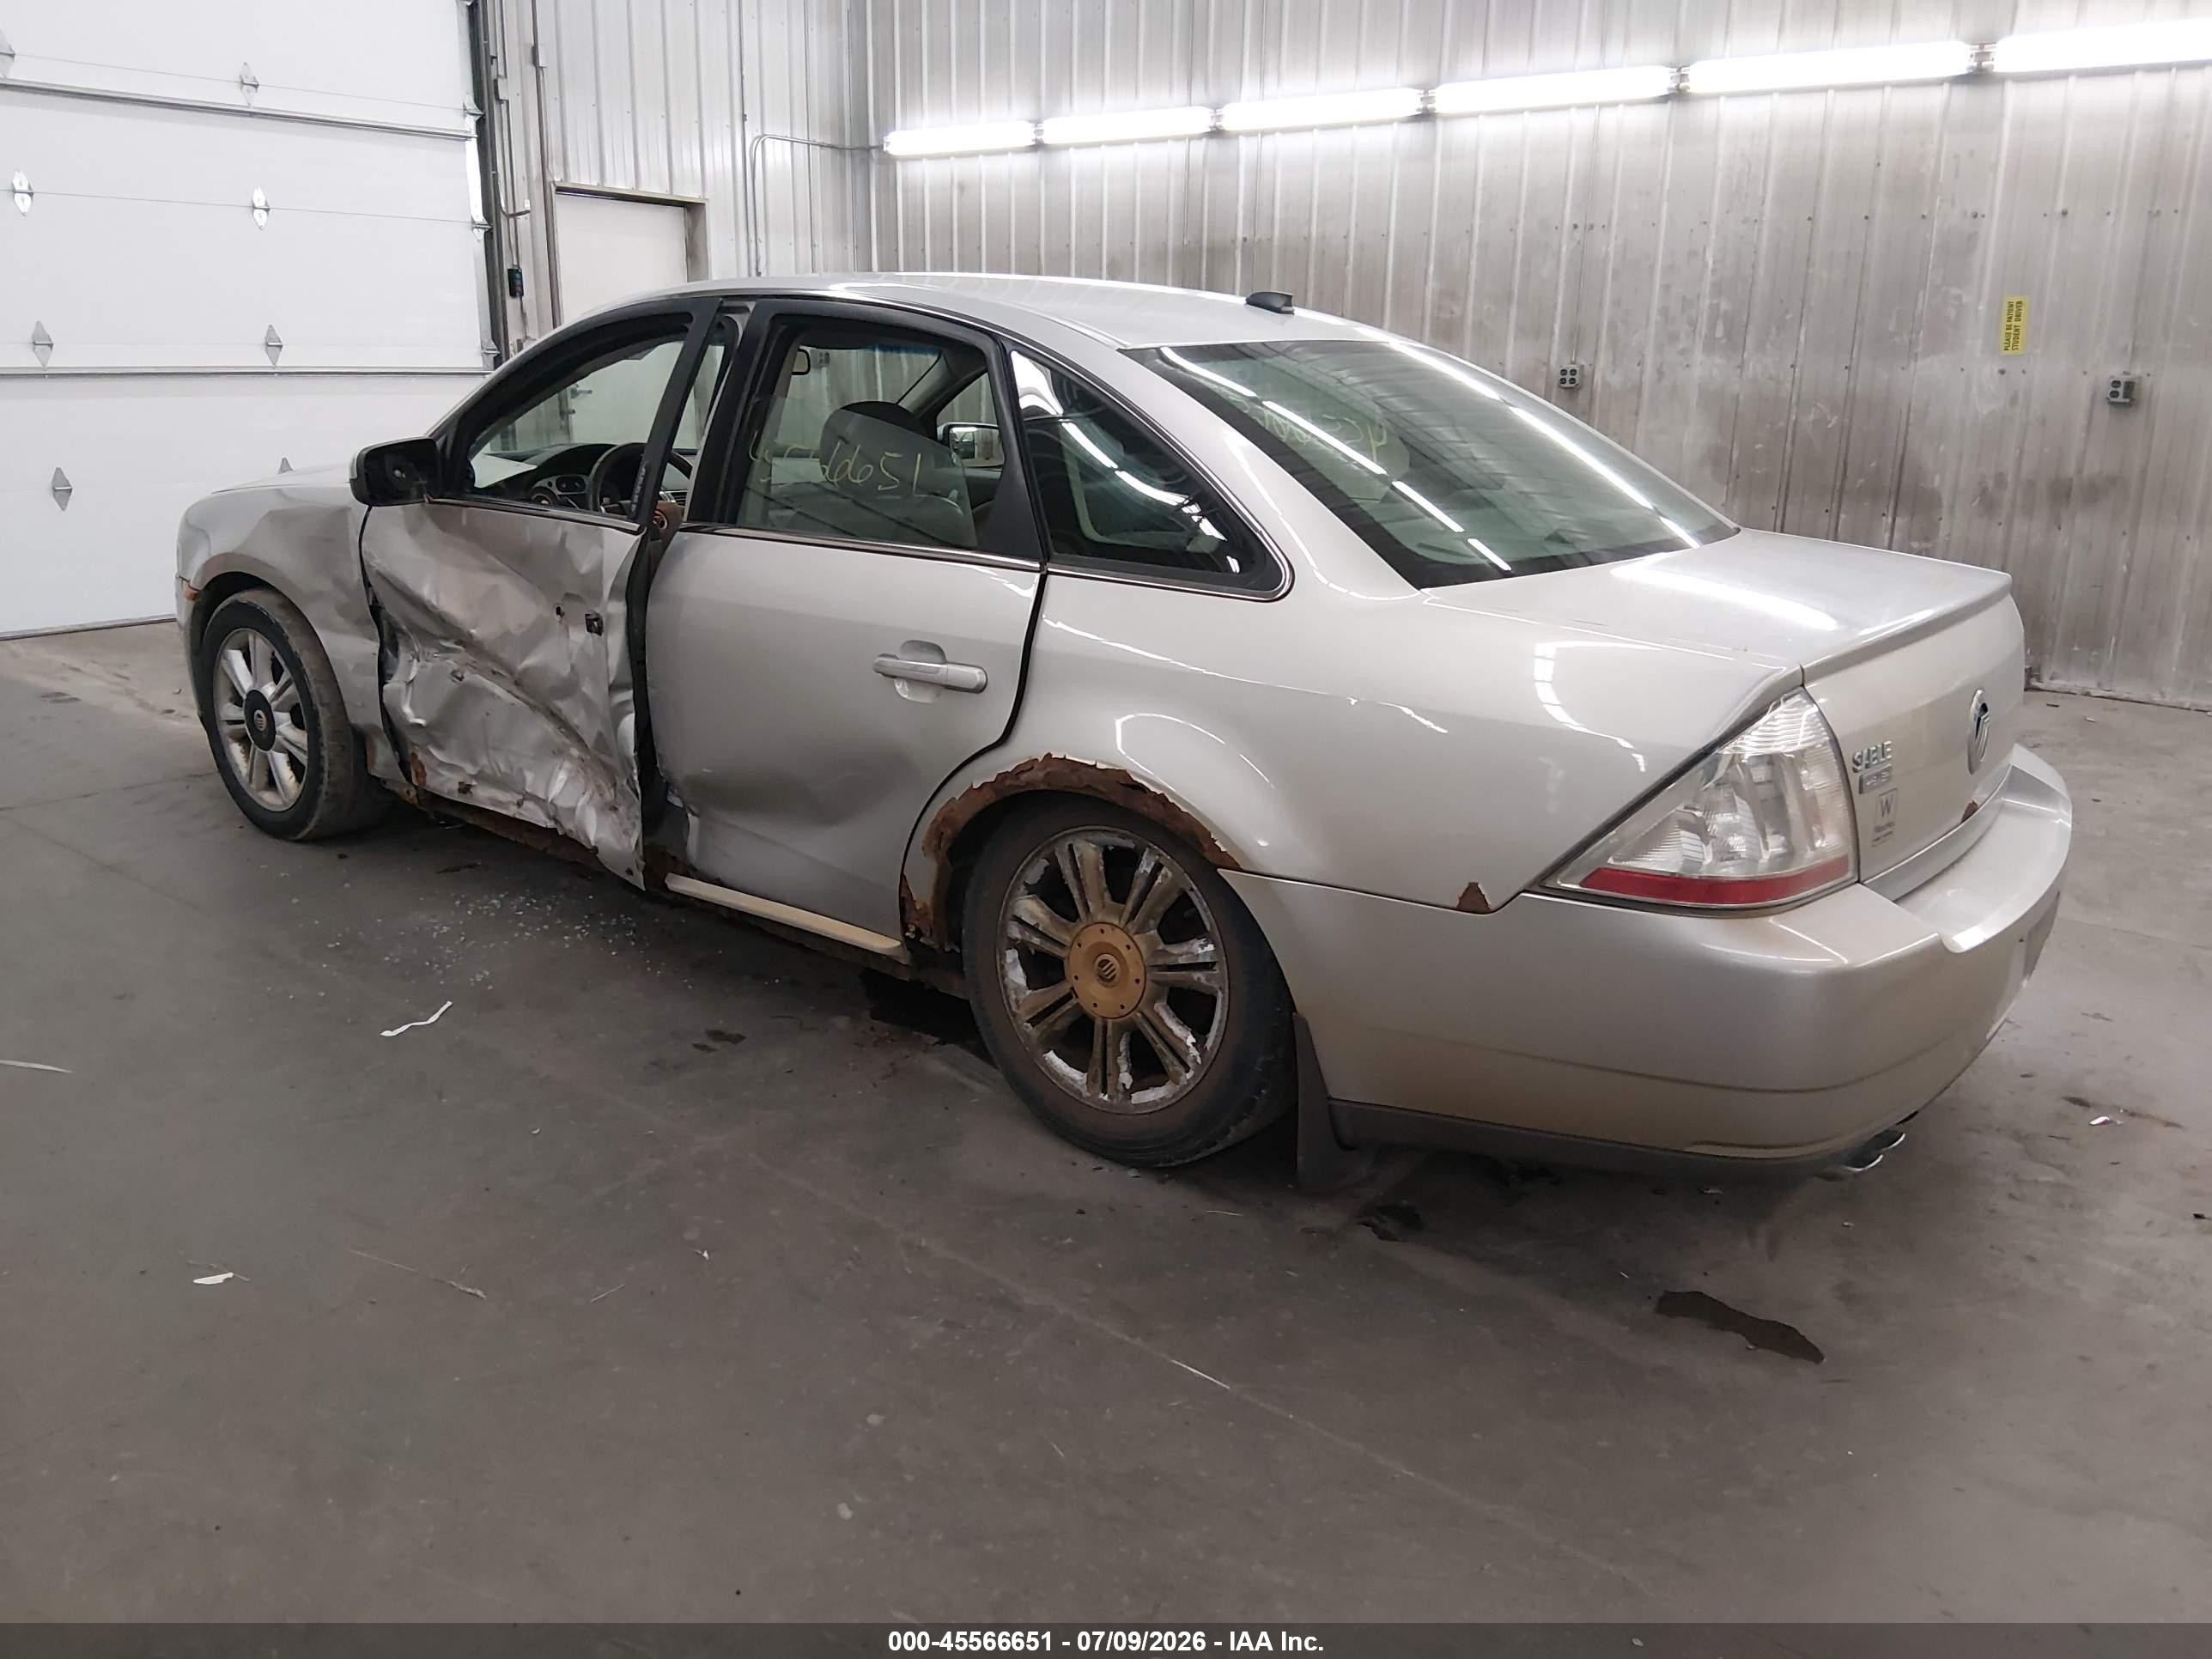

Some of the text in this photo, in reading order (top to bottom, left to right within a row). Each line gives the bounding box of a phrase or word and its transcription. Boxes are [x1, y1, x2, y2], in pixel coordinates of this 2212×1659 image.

[2006, 301, 2014, 323] PATIENT
[2011, 301, 2023, 351] STUDENT DRIVER
[2003, 332, 2012, 351] PLEASE
